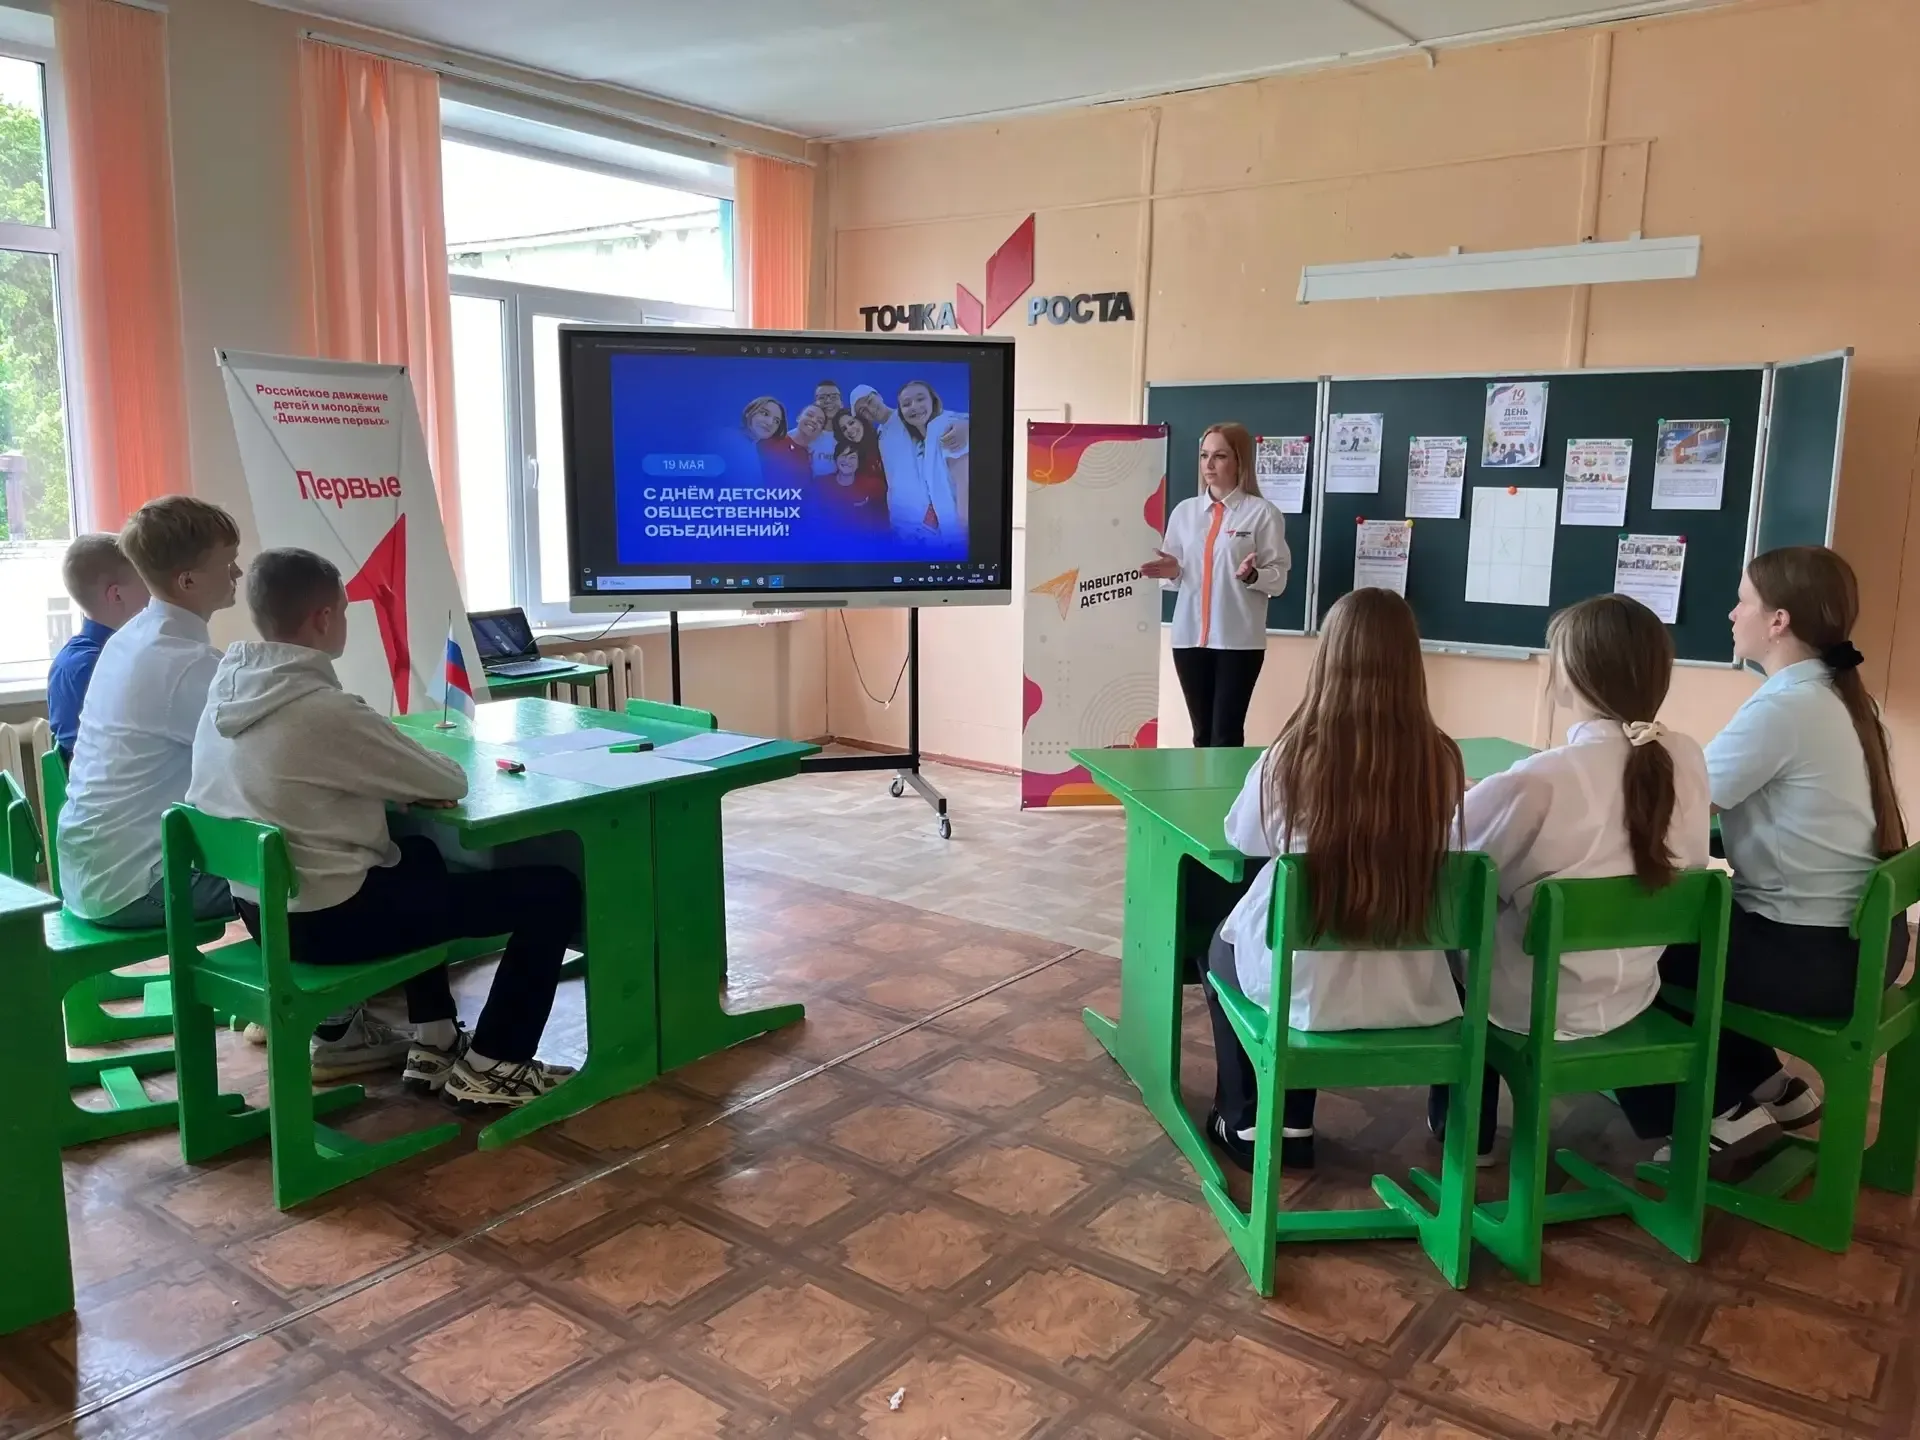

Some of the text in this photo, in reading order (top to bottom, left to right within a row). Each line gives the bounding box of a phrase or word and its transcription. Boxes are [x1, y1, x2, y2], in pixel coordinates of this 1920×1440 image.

[859, 291, 1135, 332] ТОЧКА РОСТА
[256, 384, 389, 402] Российское движение
[1511, 388, 1526, 401] 19
[274, 401, 310, 411] детей
[321, 403, 380, 413] молодёжи
[1503, 408, 1529, 417] ДЕНЬ
[273, 412, 389, 426] «Движение первых»
[662, 460, 705, 470] 19 МАЯ
[296, 470, 401, 509] Первые
[643, 485, 802, 502] С ДНЁМ ДЕТСКИХ
[643, 506, 801, 520] ОБЩЕСТВЕННЫХ
[644, 521, 790, 539] ОБЪЕДИНЕНИЙ!
[1080, 586, 1133, 608] ДЕТСТВА
